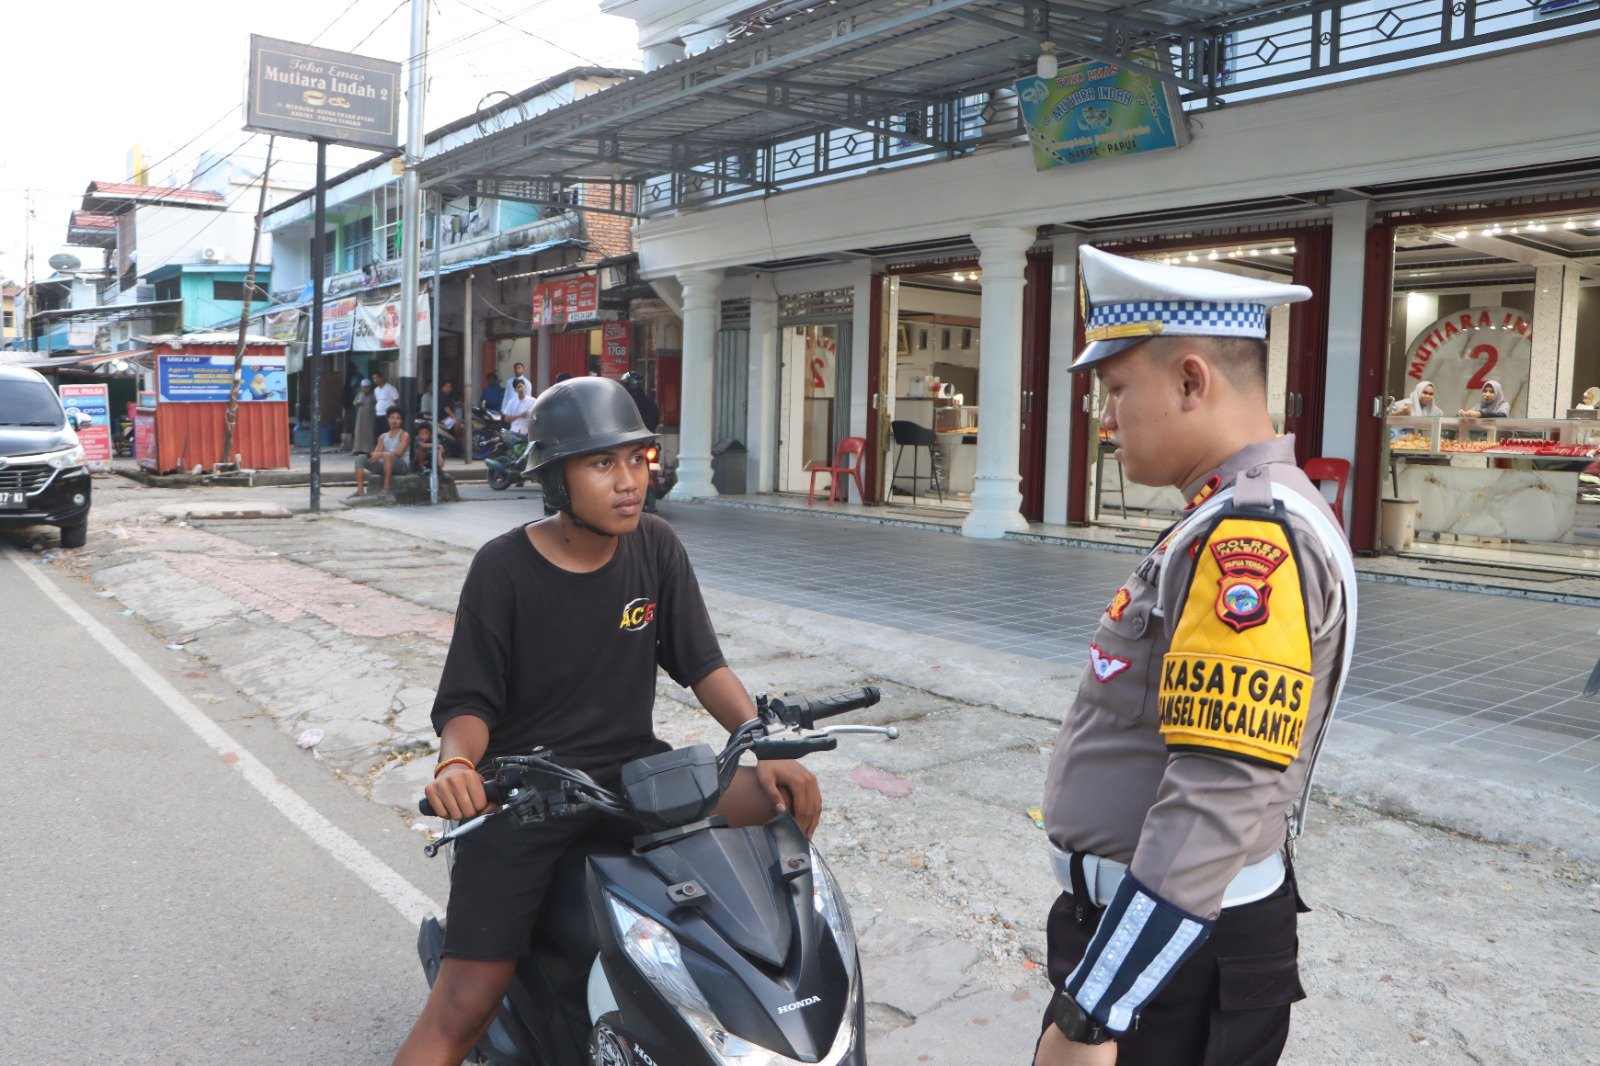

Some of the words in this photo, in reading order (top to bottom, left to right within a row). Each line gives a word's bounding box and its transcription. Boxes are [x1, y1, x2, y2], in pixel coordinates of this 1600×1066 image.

[265, 66, 326, 90] Mutiara
[331, 78, 376, 98] Indah
[379, 88, 388, 100] 2
[289, 59, 324, 74] Toko
[328, 66, 365, 81] Emas
[1056, 72, 1085, 88] TOKO
[1087, 64, 1119, 81] EMAS
[1051, 86, 1096, 121] MUTIARA
[1098, 85, 1134, 106] INDAH
[1068, 145, 1099, 160] NABIRE
[1107, 139, 1138, 153] PAPUA
[1408, 309, 1492, 381] MUTIARA
[1503, 312, 1533, 342] IN
[1466, 343, 1499, 389] 2
[1216, 539, 1282, 559] POLRES
[1163, 659, 1304, 712] KASATGAS
[776, 995, 822, 1015] HONDA
